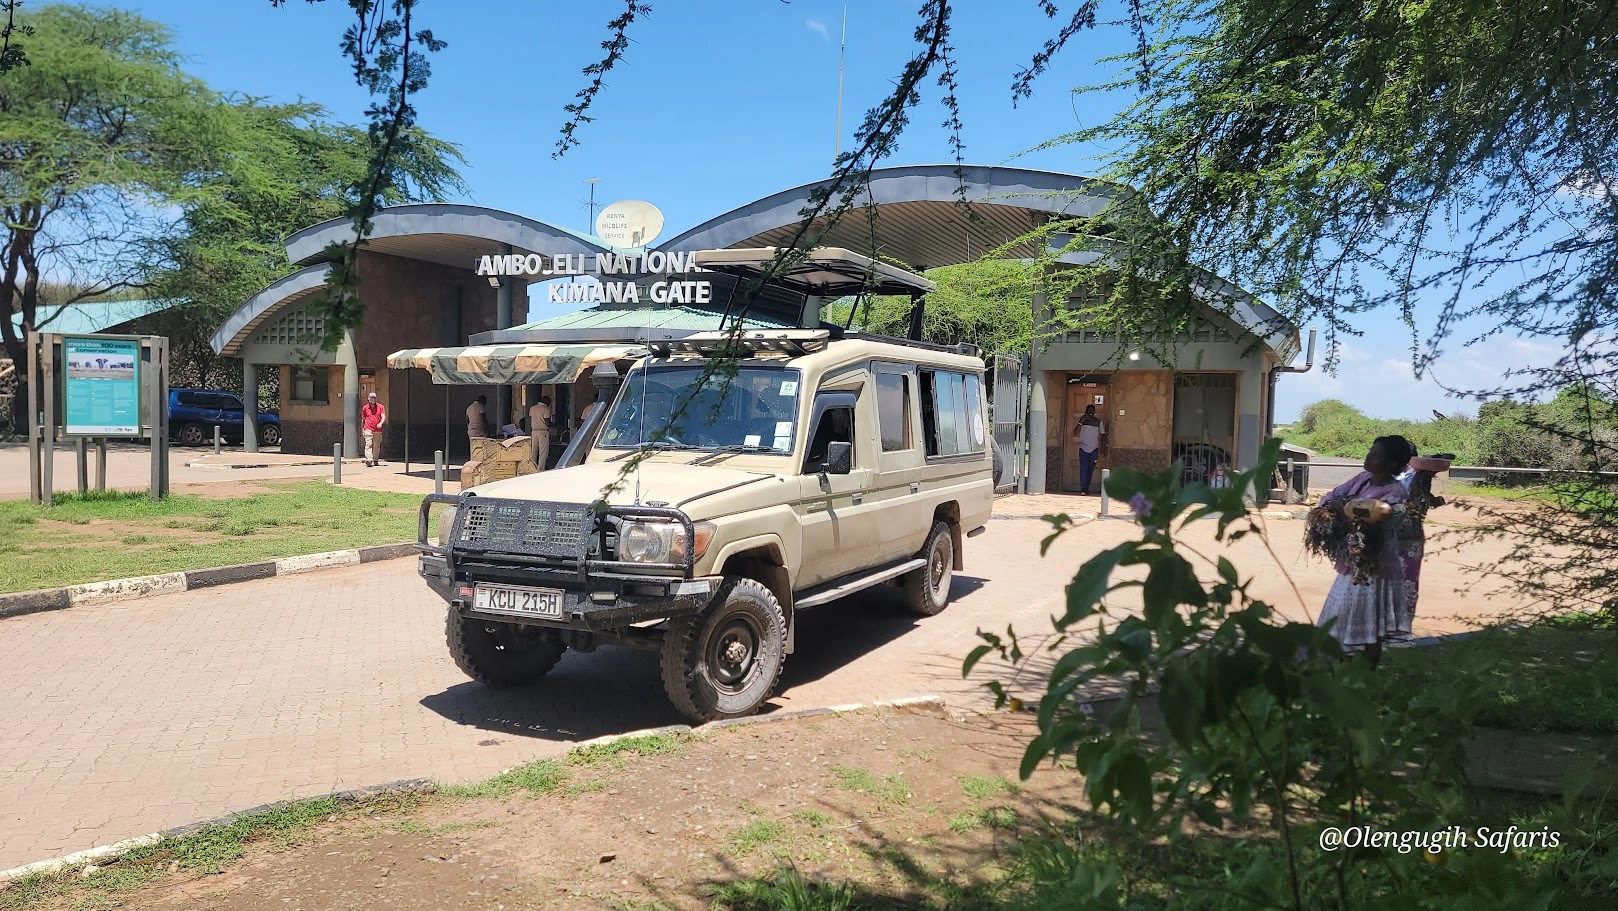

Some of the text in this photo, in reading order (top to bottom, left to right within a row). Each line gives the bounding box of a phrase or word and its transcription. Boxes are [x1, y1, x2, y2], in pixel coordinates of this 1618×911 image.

[477, 250, 717, 276] AMBOELI NATIONA
[548, 281, 711, 304] KIMANA GATE
[488, 589, 557, 614] KCU 215H
